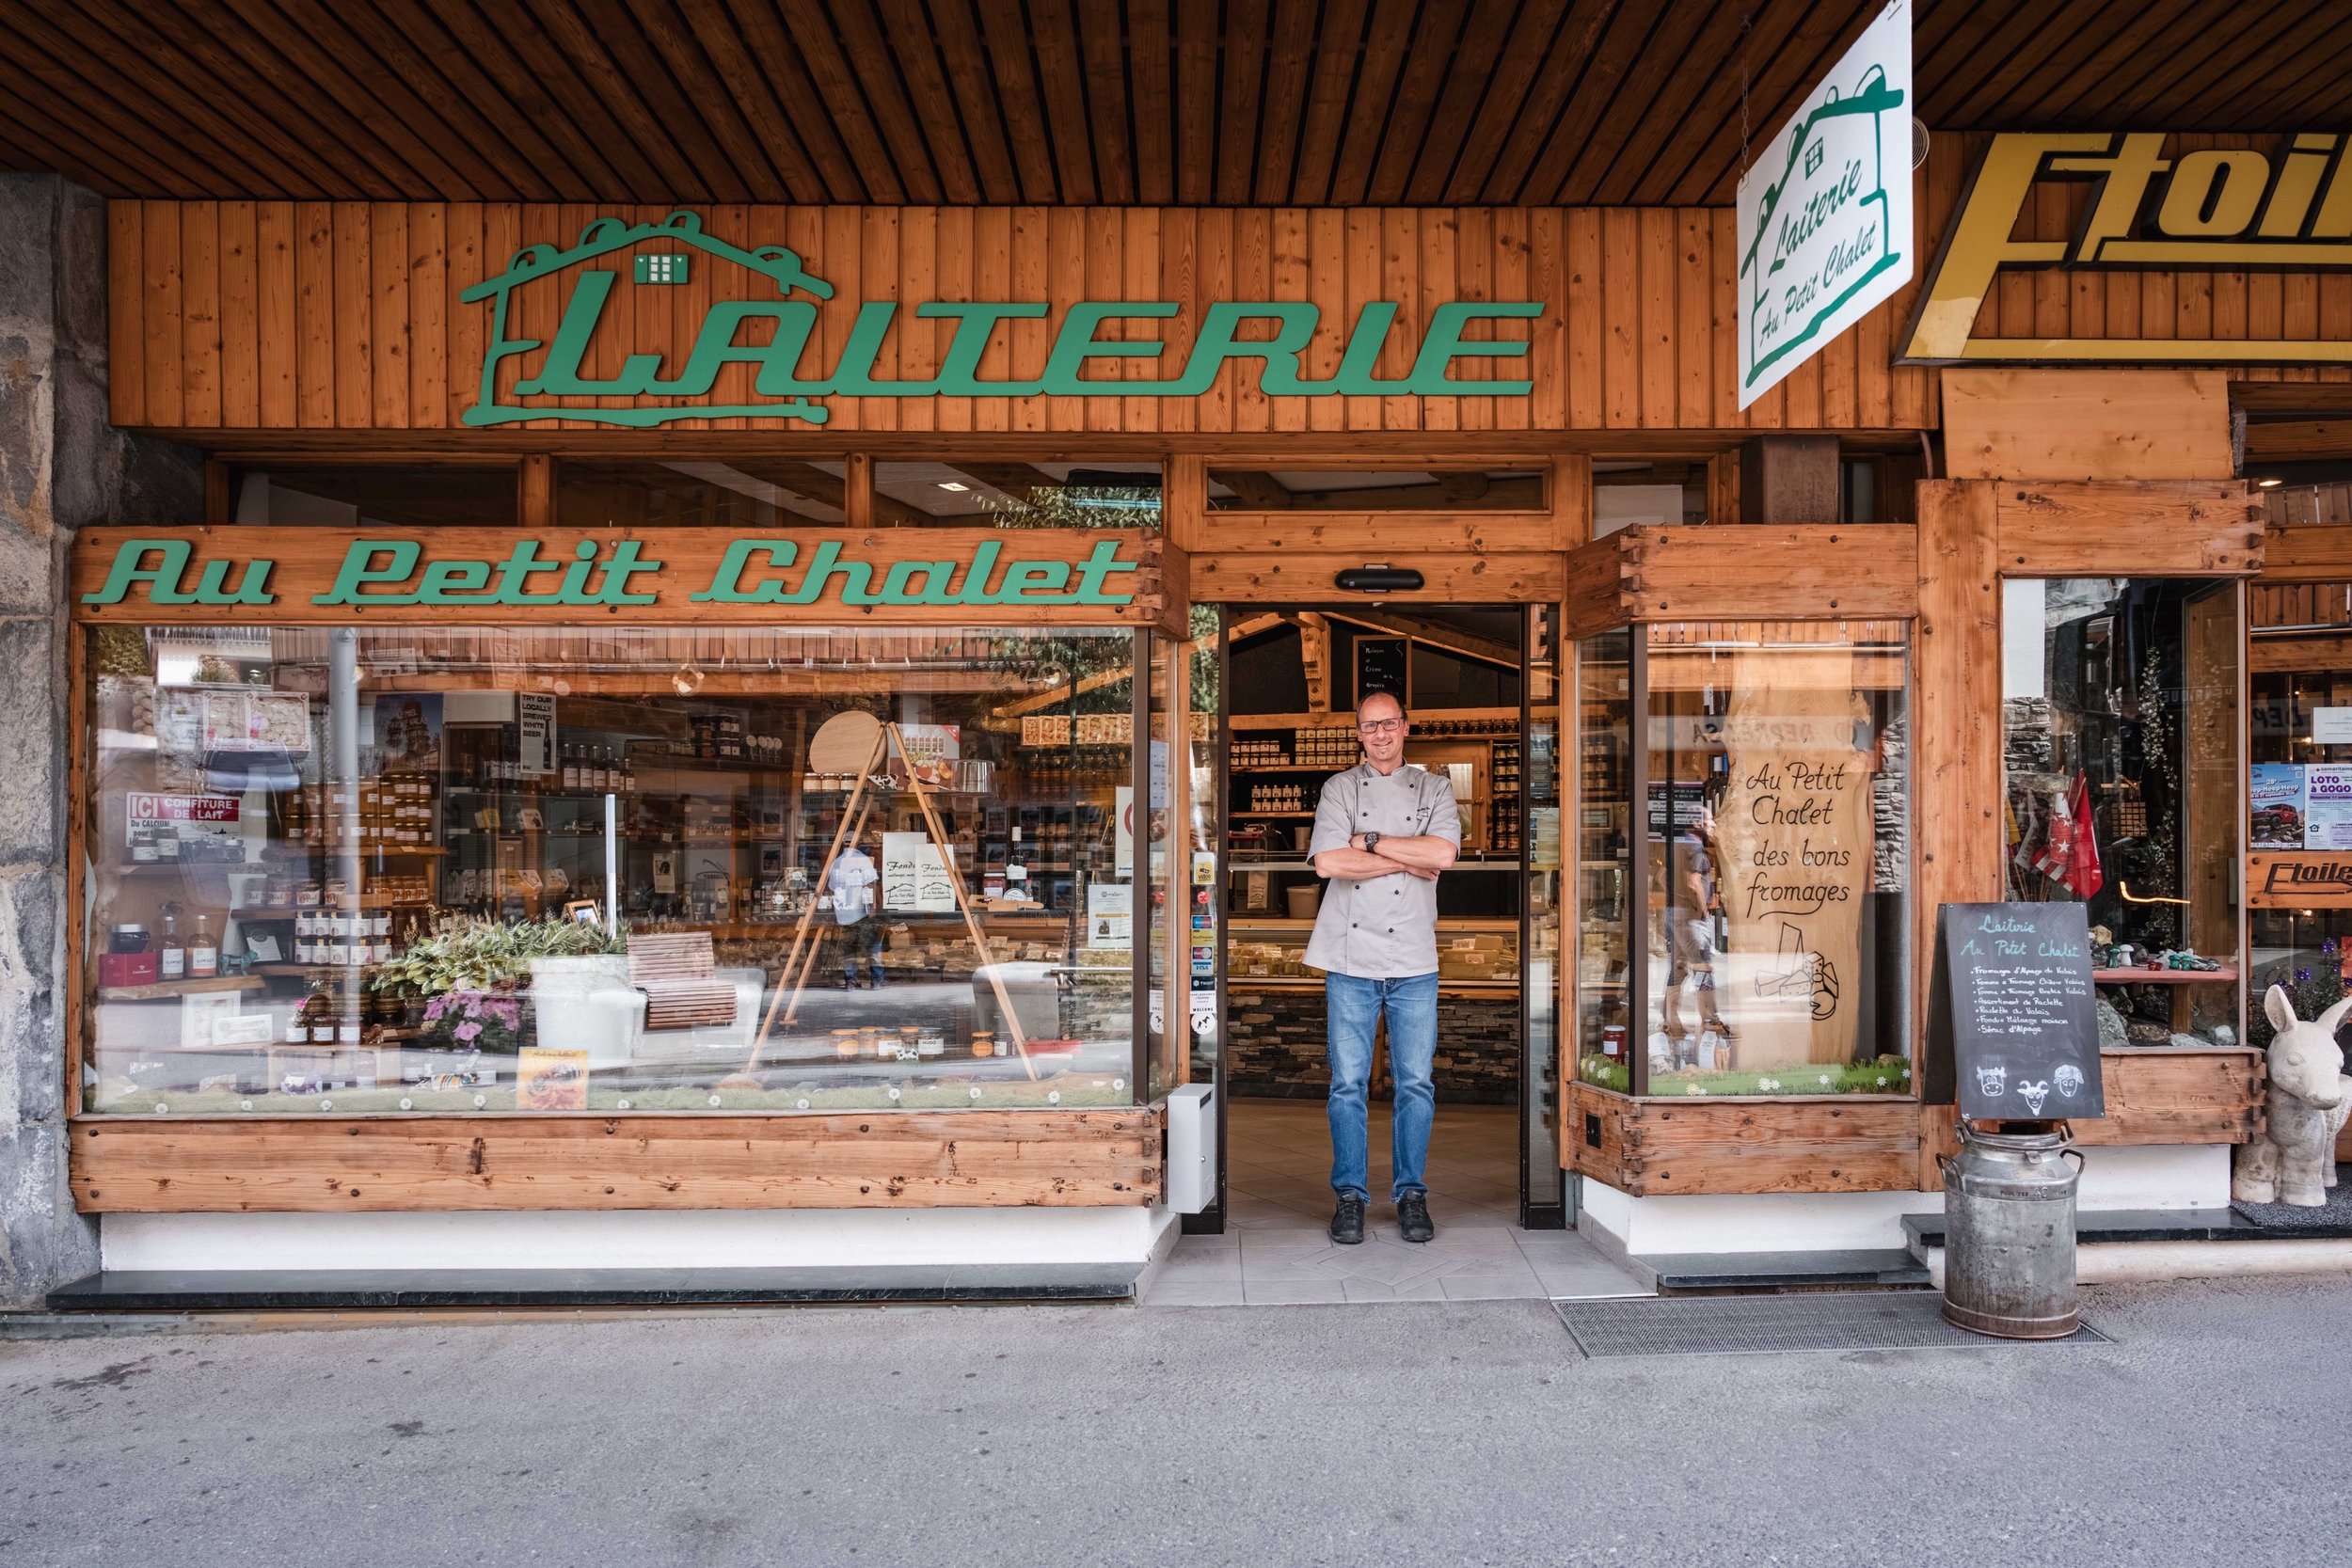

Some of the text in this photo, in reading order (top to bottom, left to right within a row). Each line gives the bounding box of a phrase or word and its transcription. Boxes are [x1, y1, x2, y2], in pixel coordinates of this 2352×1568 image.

[1768, 158, 1862, 278] Laiterie
[1760, 219, 1876, 347] Au Petit Chalet
[516, 270, 1544, 396] LAITERIE
[81, 539, 1136, 605] Au Petit Chalet
[522, 704, 551, 712] LOCALLY
[522, 713, 551, 721] BREWED
[1746, 762, 1844, 790] Au Petit
[2311, 784, 2351, 793] à GOGO
[132, 797, 233, 818] ICI CONFITURE
[1752, 794, 1833, 825] Chalet
[174, 810, 224, 820] DE LAIT
[1754, 838, 1851, 866] des bons
[1747, 871, 1851, 919] fromages
[1978, 914, 2036, 933] Laiterie
[1960, 939, 2080, 958] Au Petit Chalet
[2014, 967, 2042, 975] d'Alpage
[2007, 977, 2036, 987] Fromage
[1977, 987, 1998, 995] Tomme
[2007, 988, 2035, 996] Fromage
[2065, 987, 2087, 995] Valais
[2033, 997, 2064, 1006] Raclette
[2026, 1006, 2050, 1016] Valais
[2006, 1016, 2038, 1024] Mélange
[1980, 1025, 2042, 1035] Sérac d'Alpage
